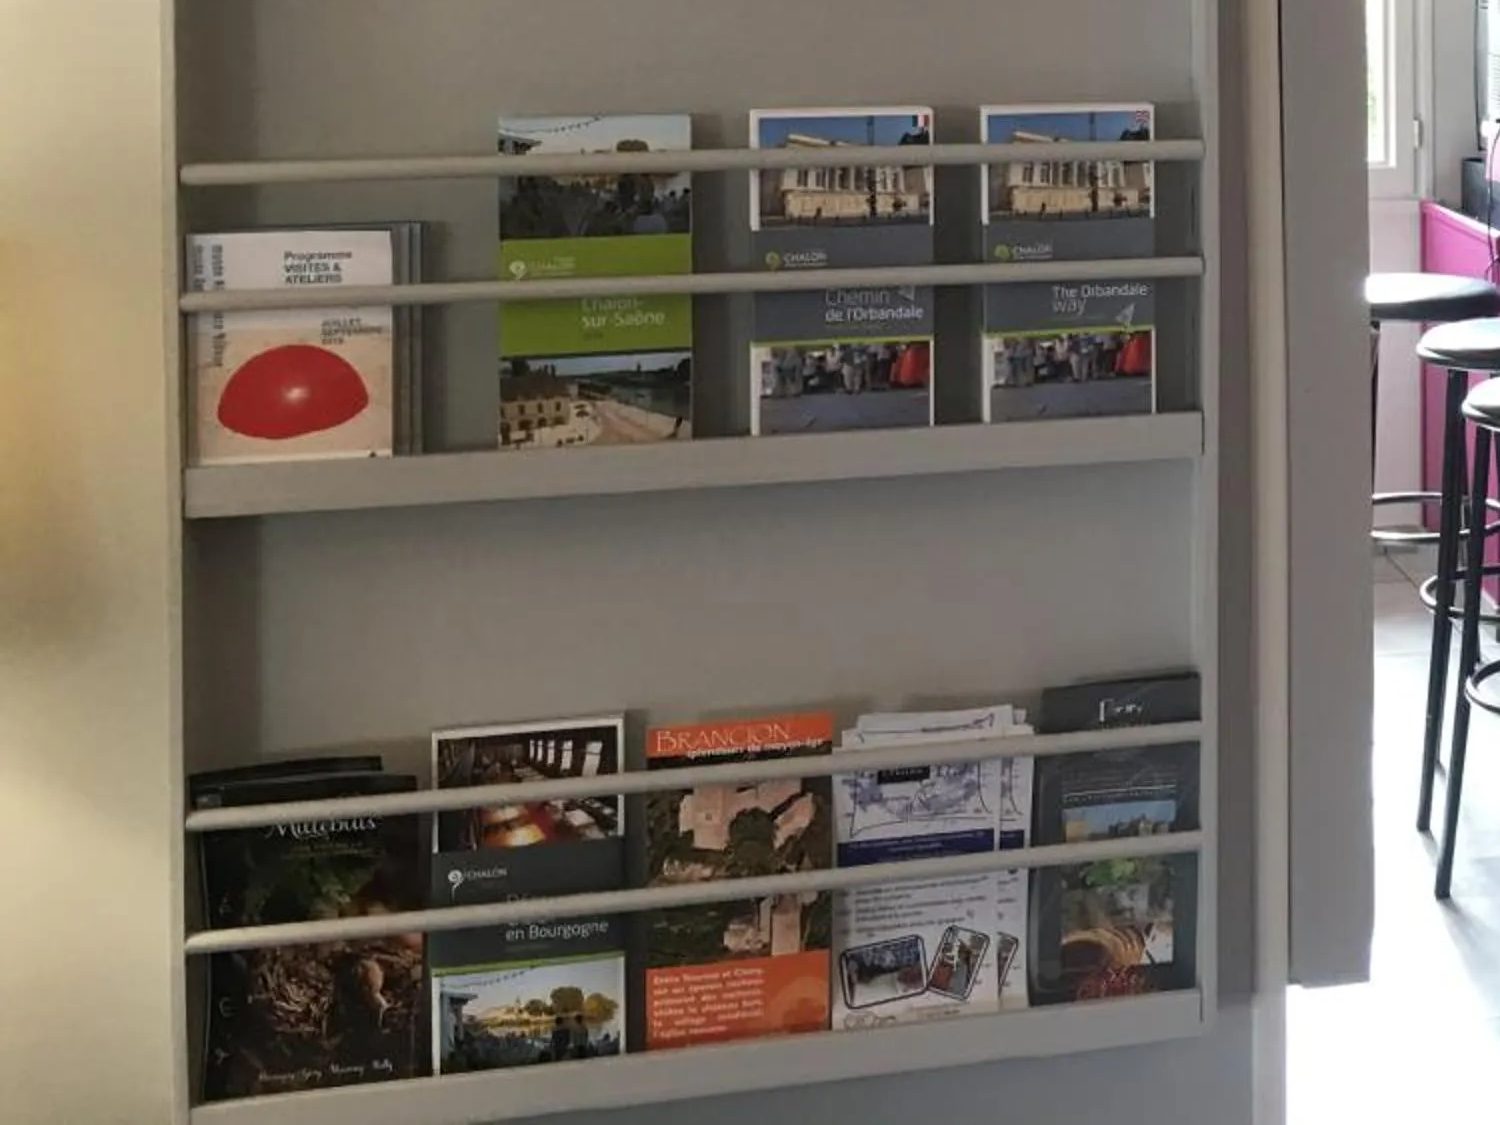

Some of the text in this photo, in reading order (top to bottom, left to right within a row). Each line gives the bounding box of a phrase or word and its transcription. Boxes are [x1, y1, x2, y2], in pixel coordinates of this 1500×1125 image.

[1052, 284, 1078, 299] The
[825, 308, 845, 322] de
[656, 722, 791, 753] BRANCION
[505, 921, 610, 941] en Bourgogne
